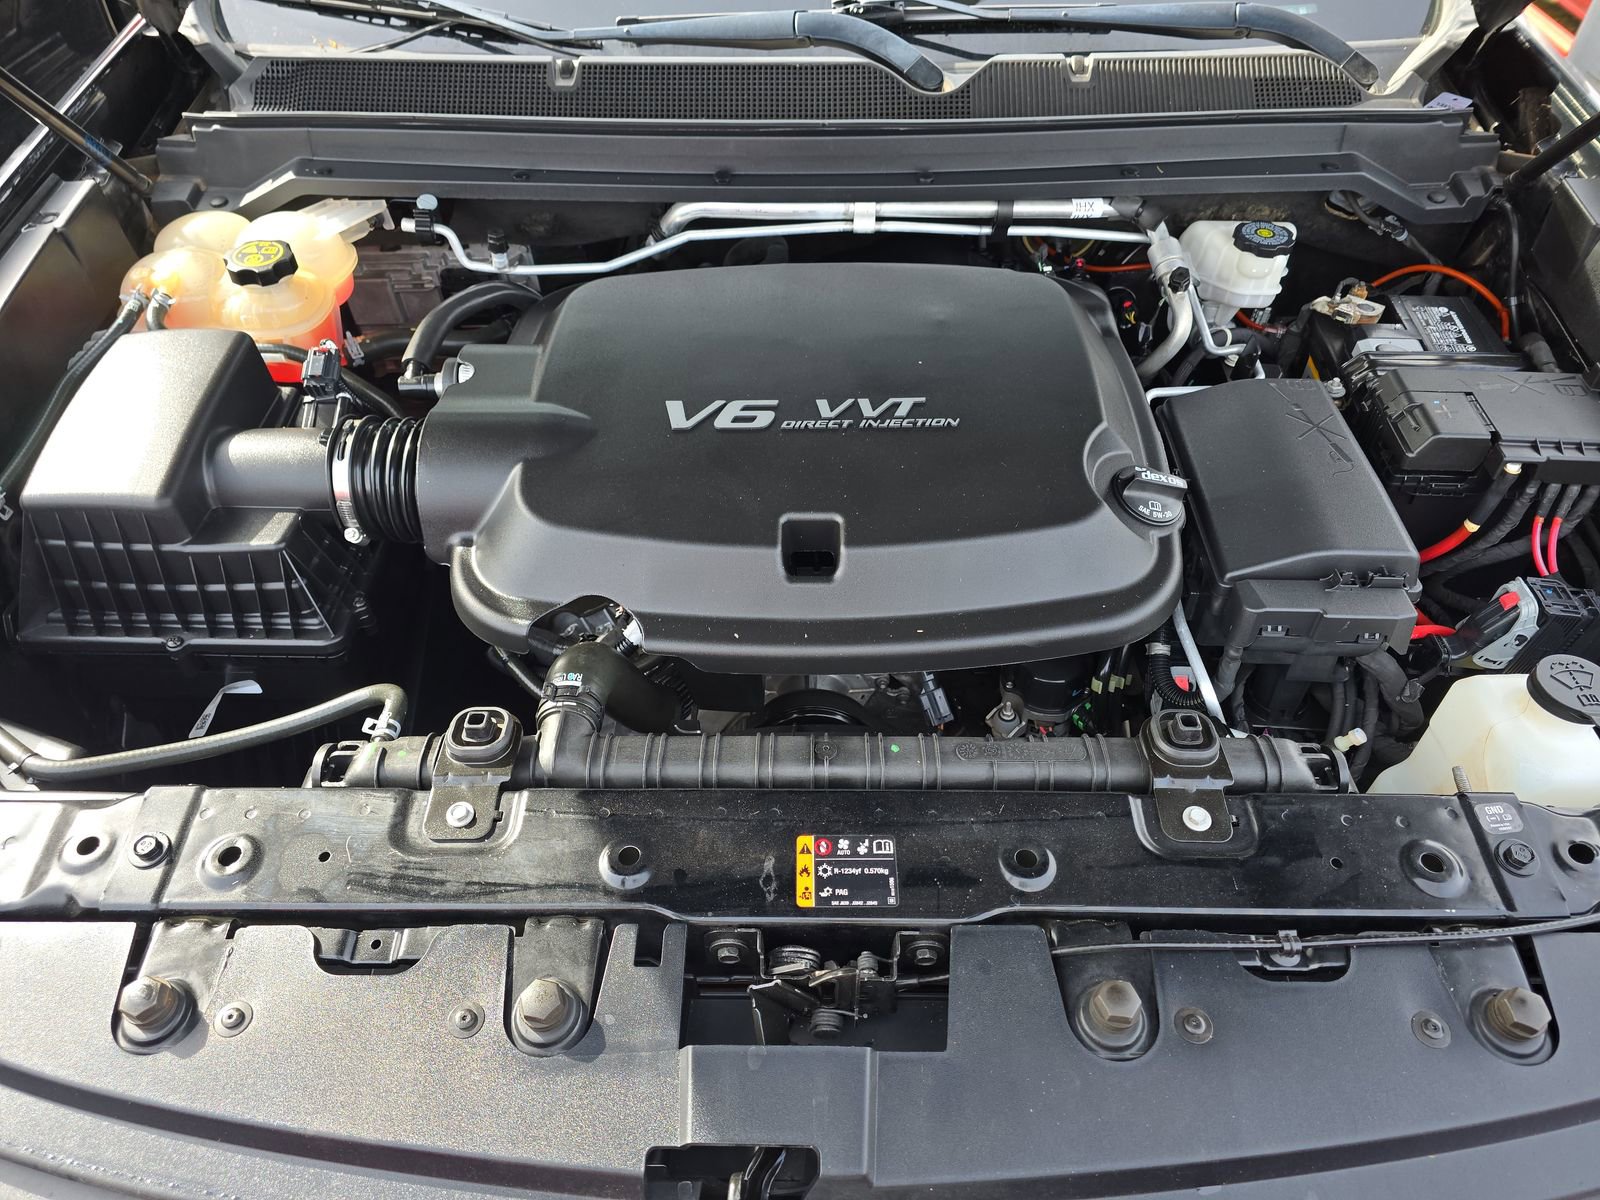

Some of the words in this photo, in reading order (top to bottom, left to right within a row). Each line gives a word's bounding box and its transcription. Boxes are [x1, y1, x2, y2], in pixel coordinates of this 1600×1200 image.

[665, 400, 780, 430] V6
[815, 397, 927, 418] VVT
[780, 419, 853, 430] DIRECT
[858, 417, 960, 429] INJECTION
[1141, 470, 1184, 487] dexos
[1138, 505, 1151, 515] SAE
[1485, 805, 1503, 814] GND
[834, 867, 862, 875] R-1234yf
[864, 867, 889, 875] 0.570kg
[835, 888, 848, 896] PAG
